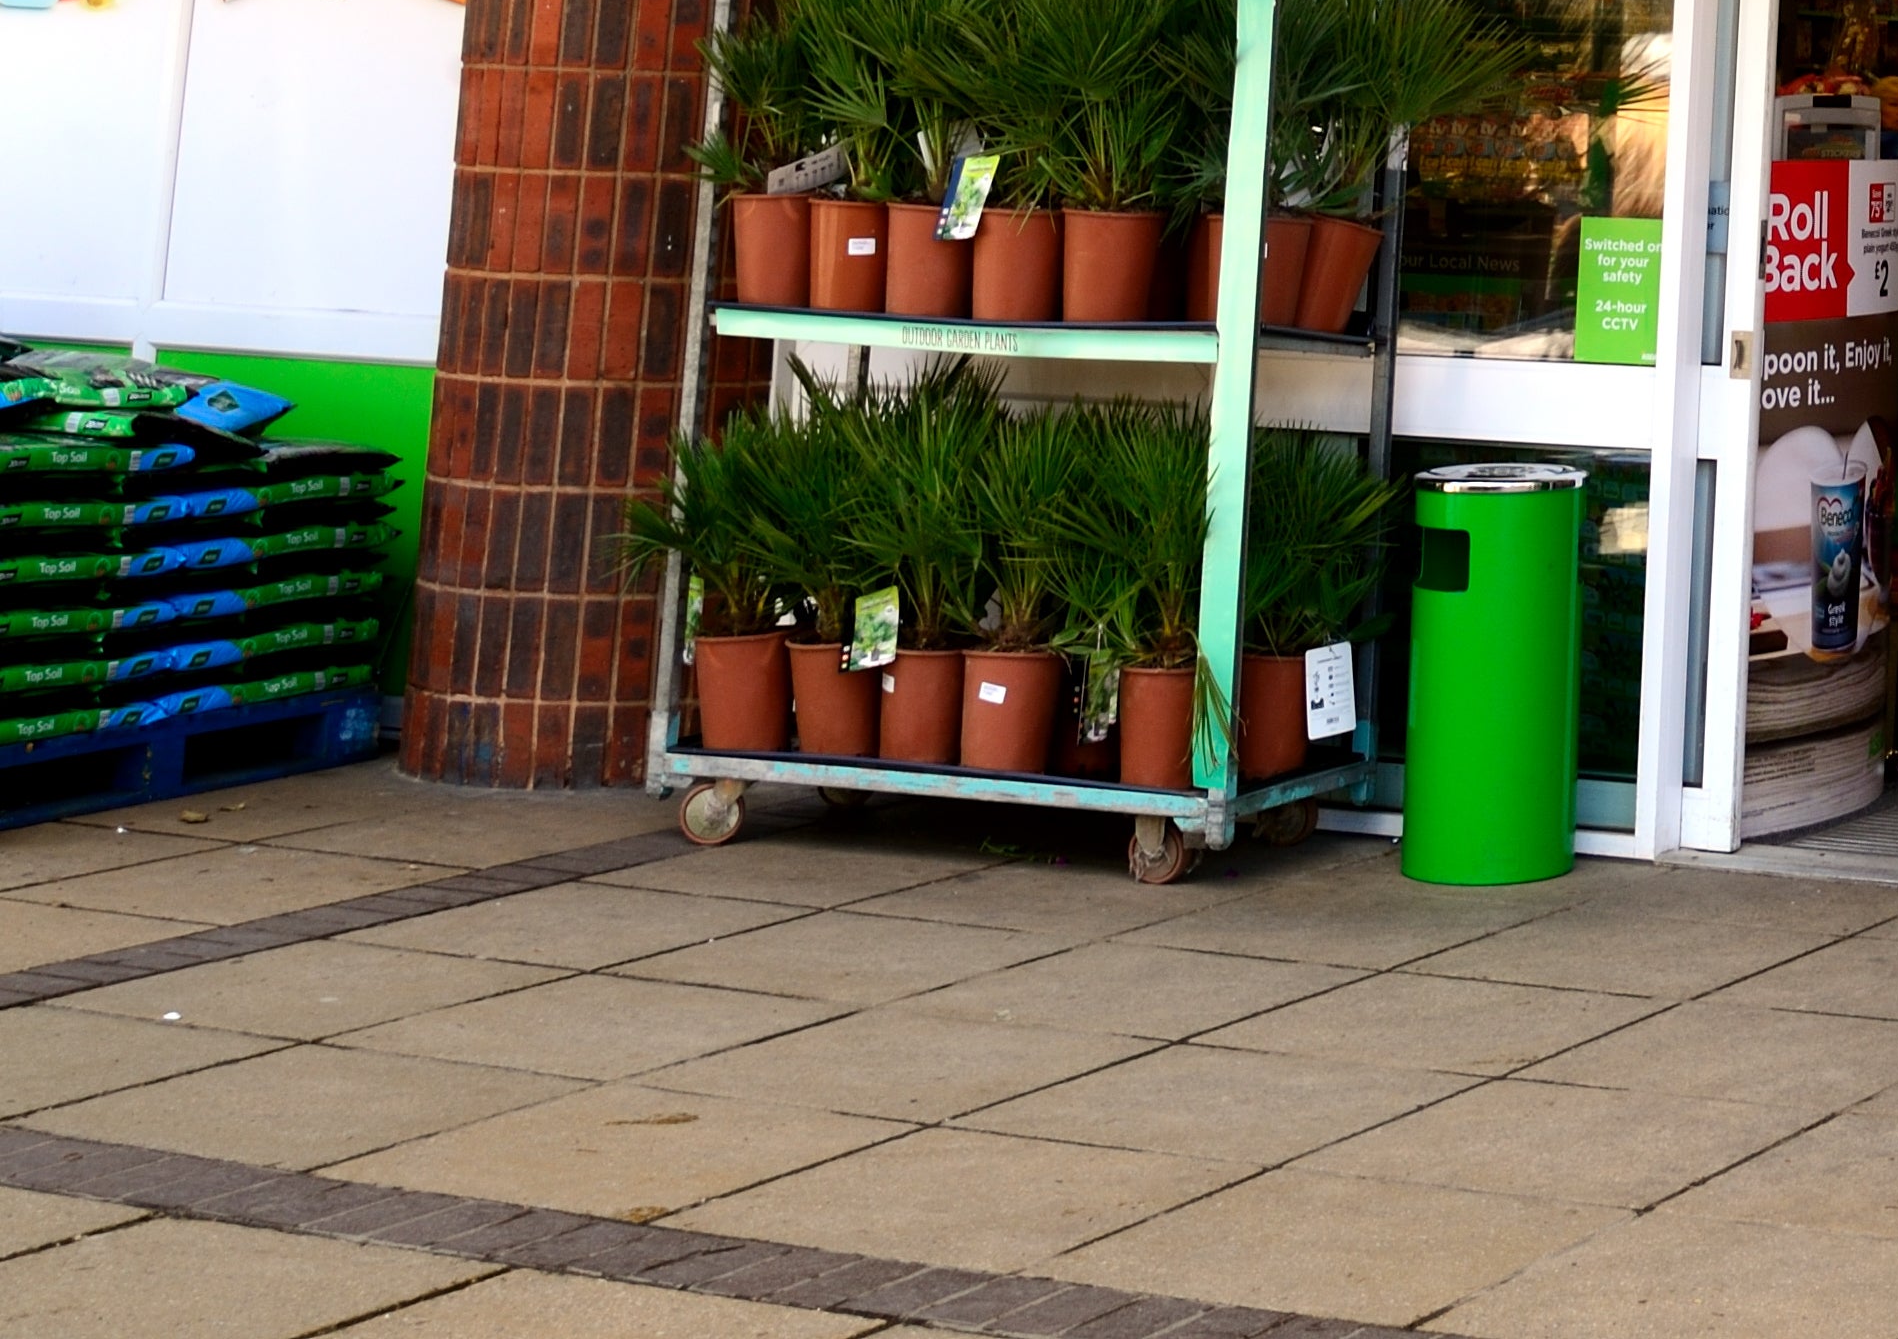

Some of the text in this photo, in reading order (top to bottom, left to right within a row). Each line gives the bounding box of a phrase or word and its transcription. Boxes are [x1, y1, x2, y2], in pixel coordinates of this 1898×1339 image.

[1768, 190, 1829, 241] Roll
[1584, 238, 1644, 253] Switched
[1429, 253, 1472, 269] Local
[1477, 255, 1520, 272] News
[1598, 254, 1649, 269] for your
[1765, 241, 1838, 293] Back
[1603, 270, 1642, 285] safety
[1875, 259, 1889, 298] £2
[1595, 300, 1647, 313] 24-hour
[1602, 317, 1638, 330] CCTV
[902, 326, 1018, 352] OUTDOOR GARDEN PLANTS
[1763, 349, 1818, 381] poon
[1824, 342, 1840, 375] it,
[1845, 339, 1880, 371] Enjoy
[1761, 378, 1835, 411] ove it...
[52, 451, 87, 463] Top Soil
[291, 481, 323, 494] Top Soil
[44, 507, 80, 520] Top Soil
[286, 531, 319, 544] Top Soil
[40, 561, 76, 575] Top Soil
[278, 580, 311, 594] Top Soil
[32, 615, 68, 629] Top Soil
[275, 630, 308, 643] Top Soil
[25, 668, 62, 683] Top Soil
[264, 678, 297, 693] Top Soil
[17, 720, 54, 735] Top Soil
